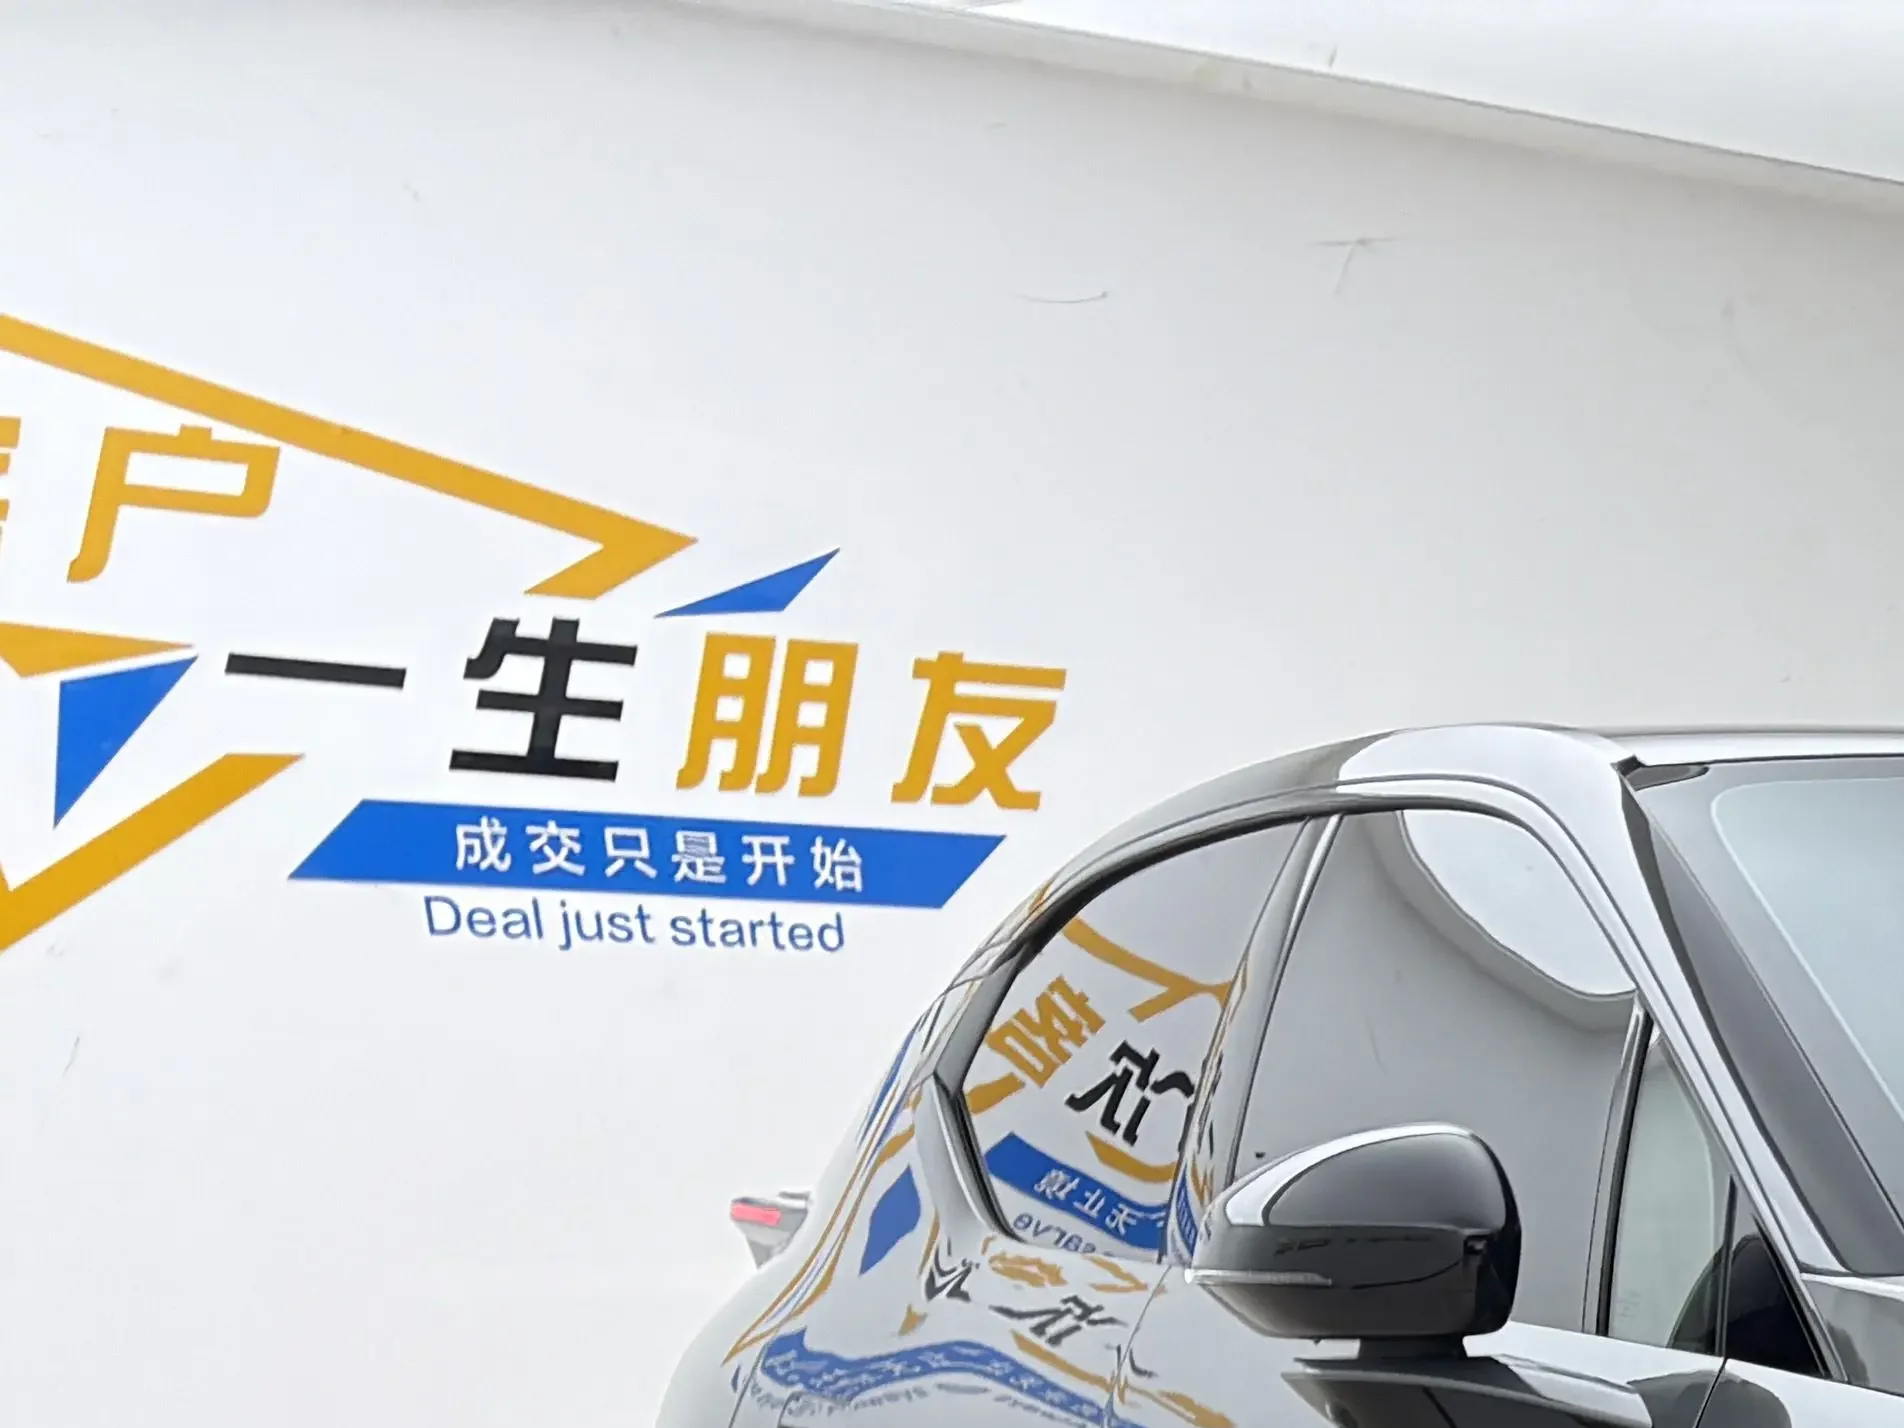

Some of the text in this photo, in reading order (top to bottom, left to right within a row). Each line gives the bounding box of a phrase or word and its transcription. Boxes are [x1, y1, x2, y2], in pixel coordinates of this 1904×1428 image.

[0, 414, 281, 583] 户
[224, 613, 1067, 812] 一生朋友
[454, 815, 864, 894] 成交只是开始
[425, 894, 846, 953] Deal just started
